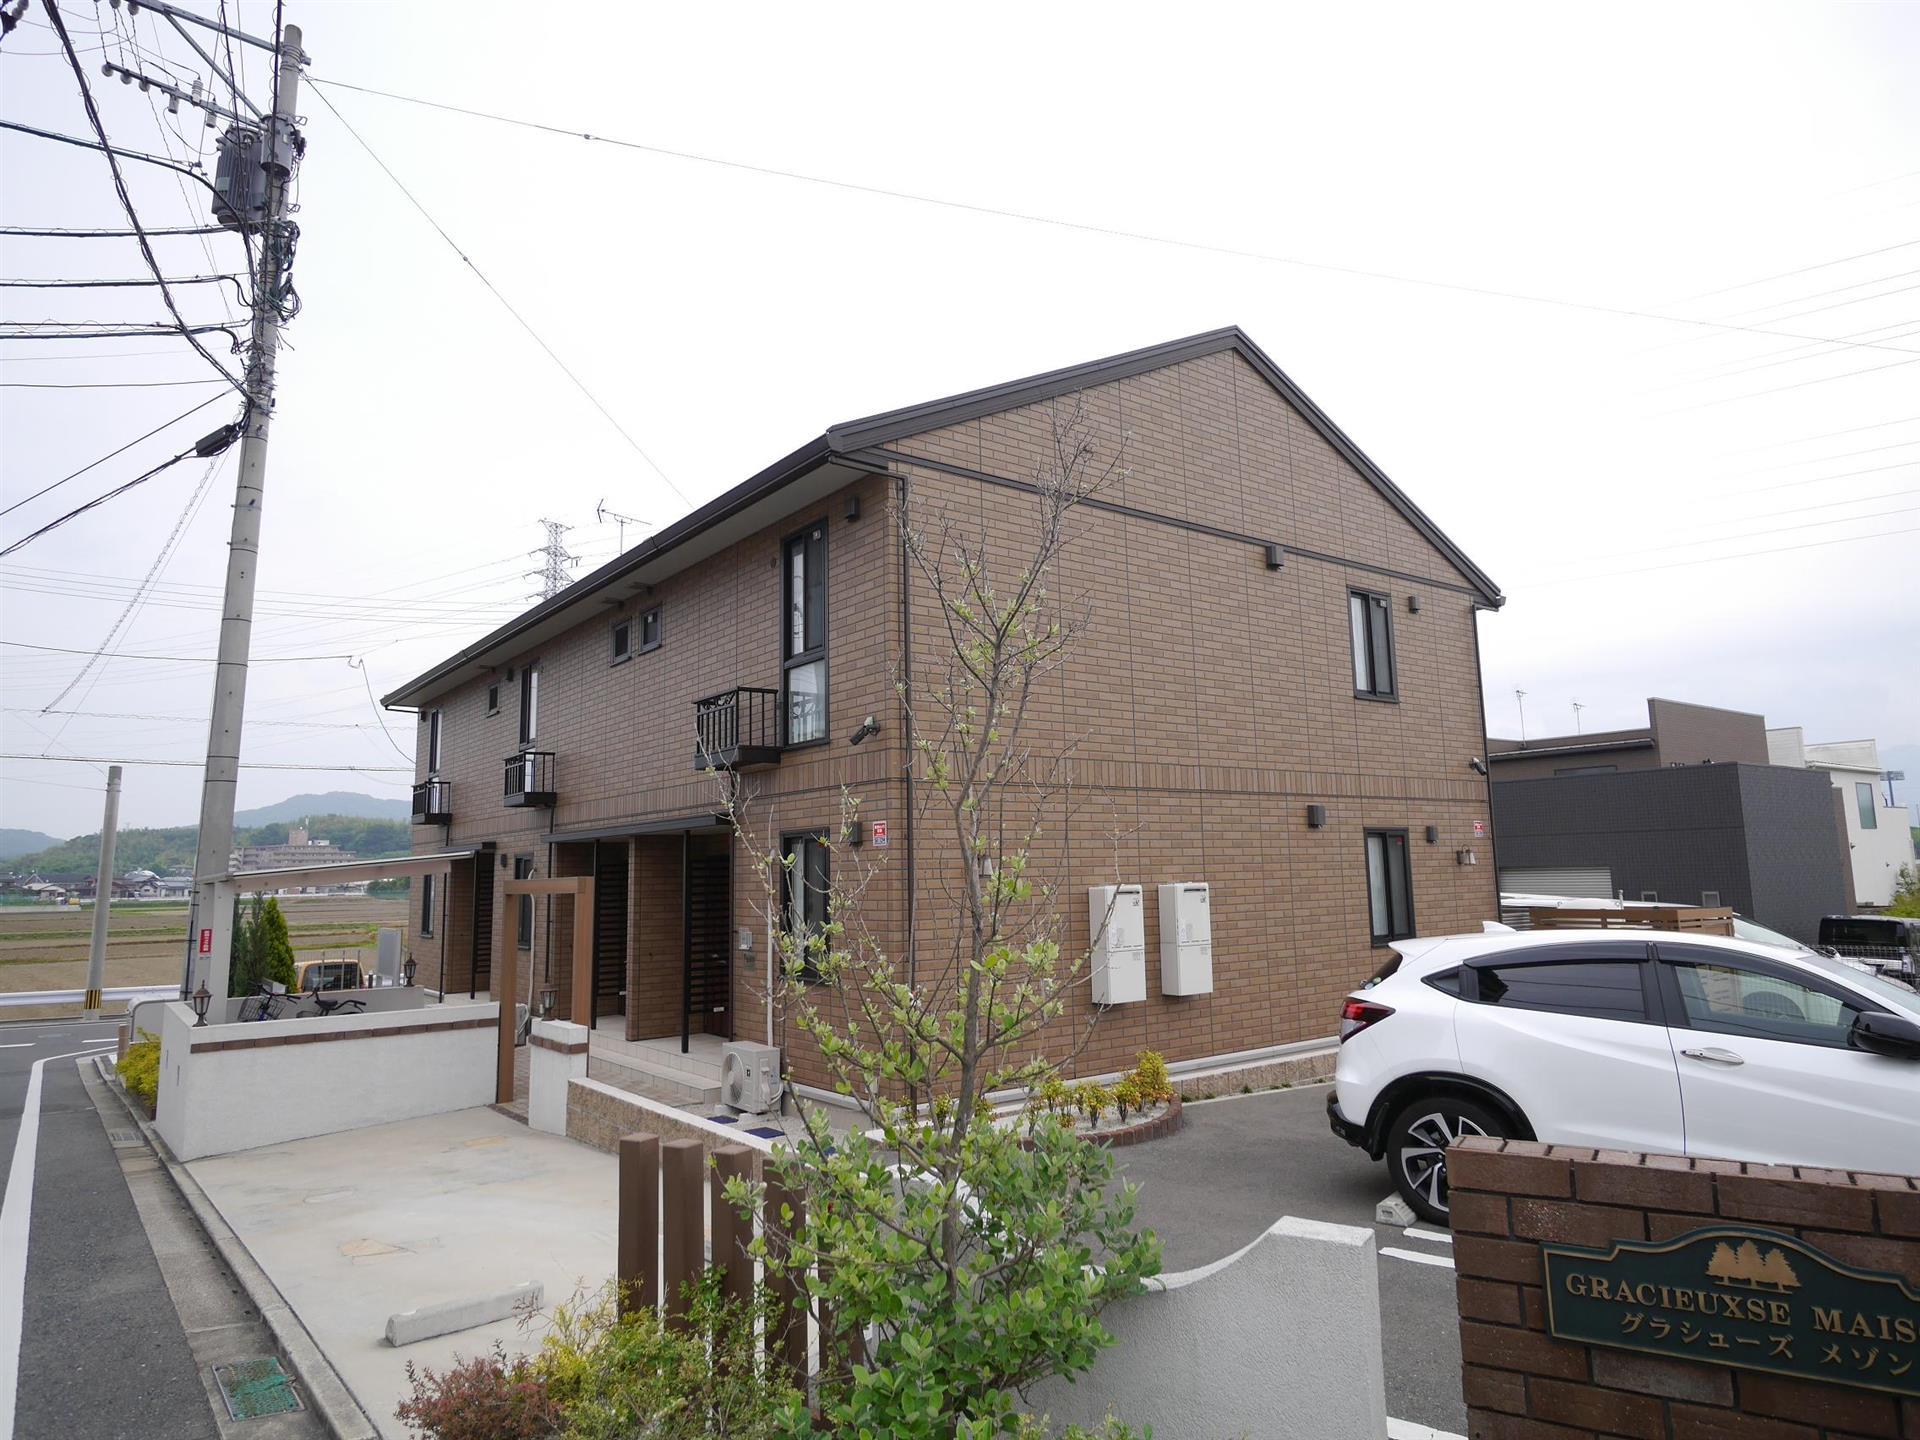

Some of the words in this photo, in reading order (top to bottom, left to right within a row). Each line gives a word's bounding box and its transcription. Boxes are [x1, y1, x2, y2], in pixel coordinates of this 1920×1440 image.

[1566, 1274, 1792, 1326] GRACIEUXSE
[1812, 1307, 1920, 1343] MAIS
[1621, 1313, 1794, 1359] グラシューズ
[1820, 1344, 1913, 1376] メゾン
